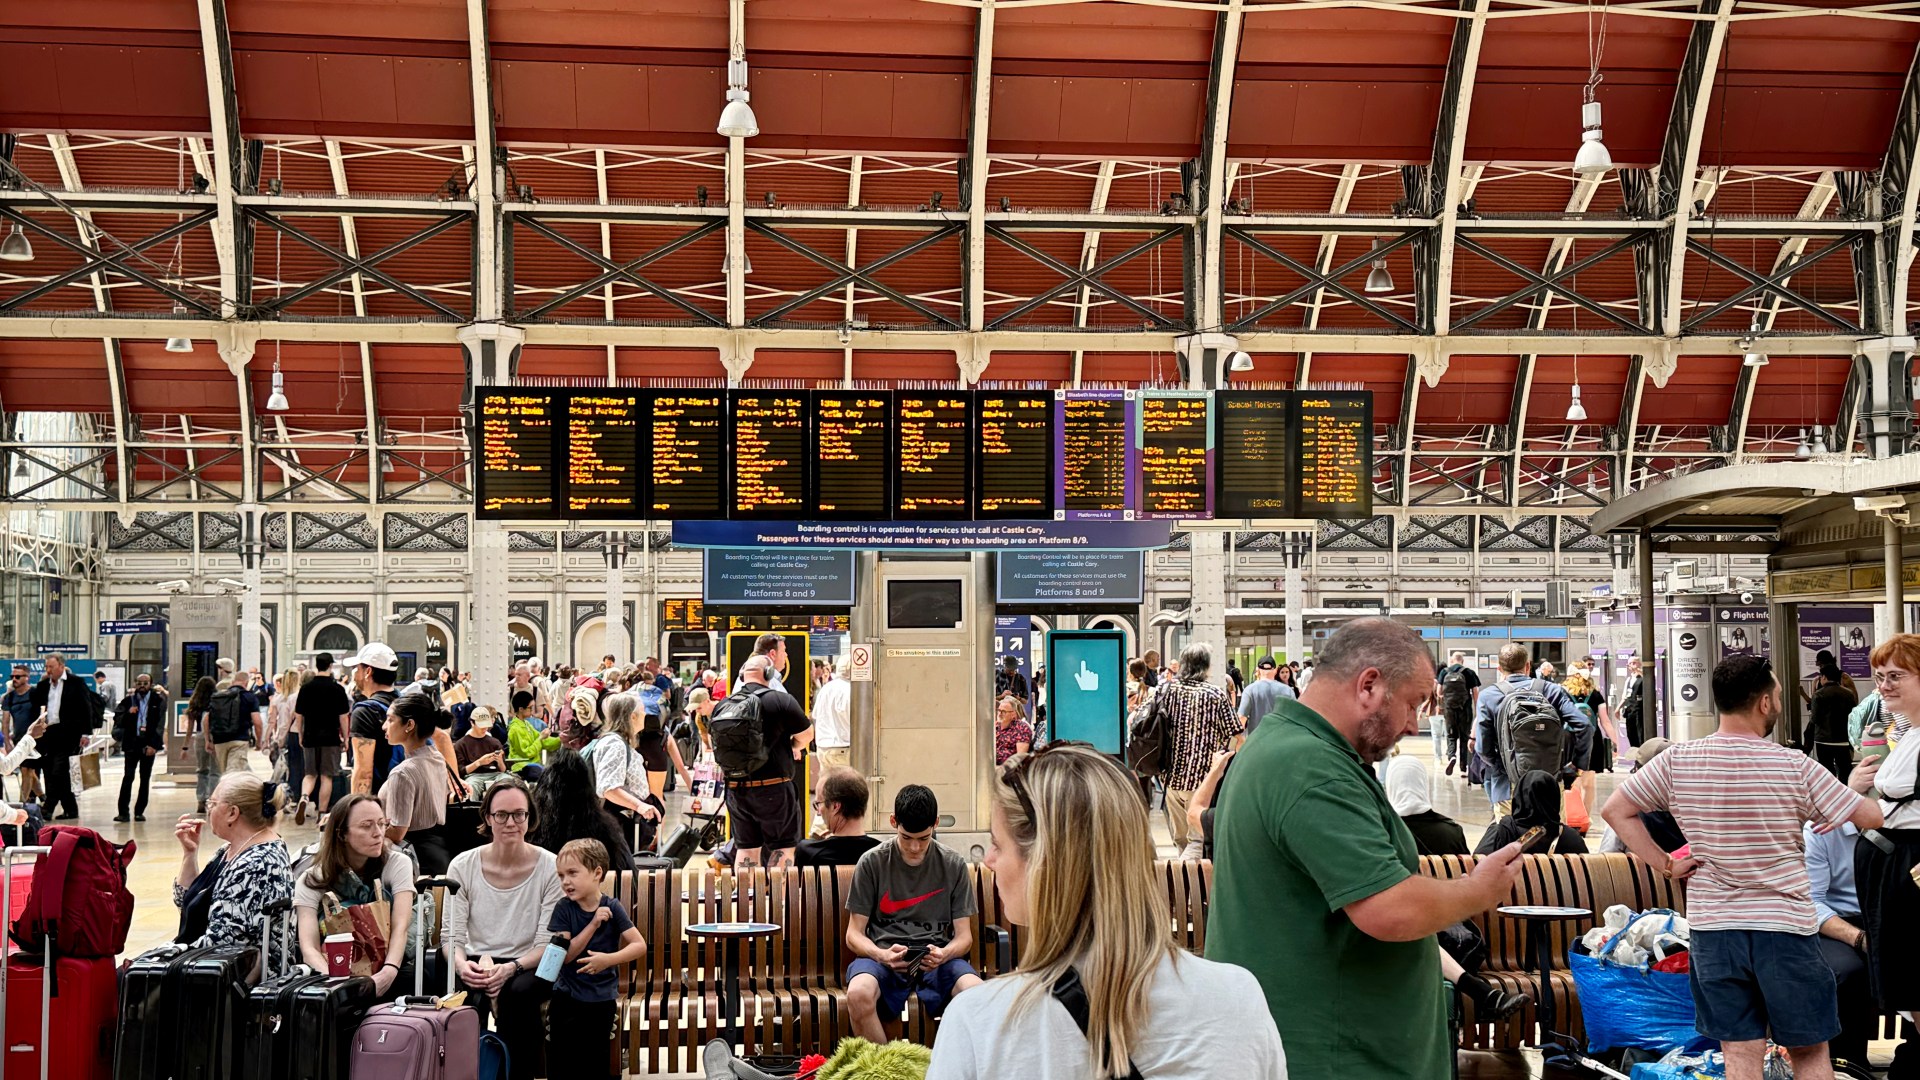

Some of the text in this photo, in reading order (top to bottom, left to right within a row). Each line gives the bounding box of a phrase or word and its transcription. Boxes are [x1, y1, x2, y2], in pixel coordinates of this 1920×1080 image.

[798, 525, 831, 533] Boarding
[1027, 526, 1045, 535] Cary.
[757, 535, 799, 543] Passengers
[976, 537, 1007, 545] boarding
[180, 601, 219, 611] Paddingto
[1733, 612, 1754, 620] Flight
